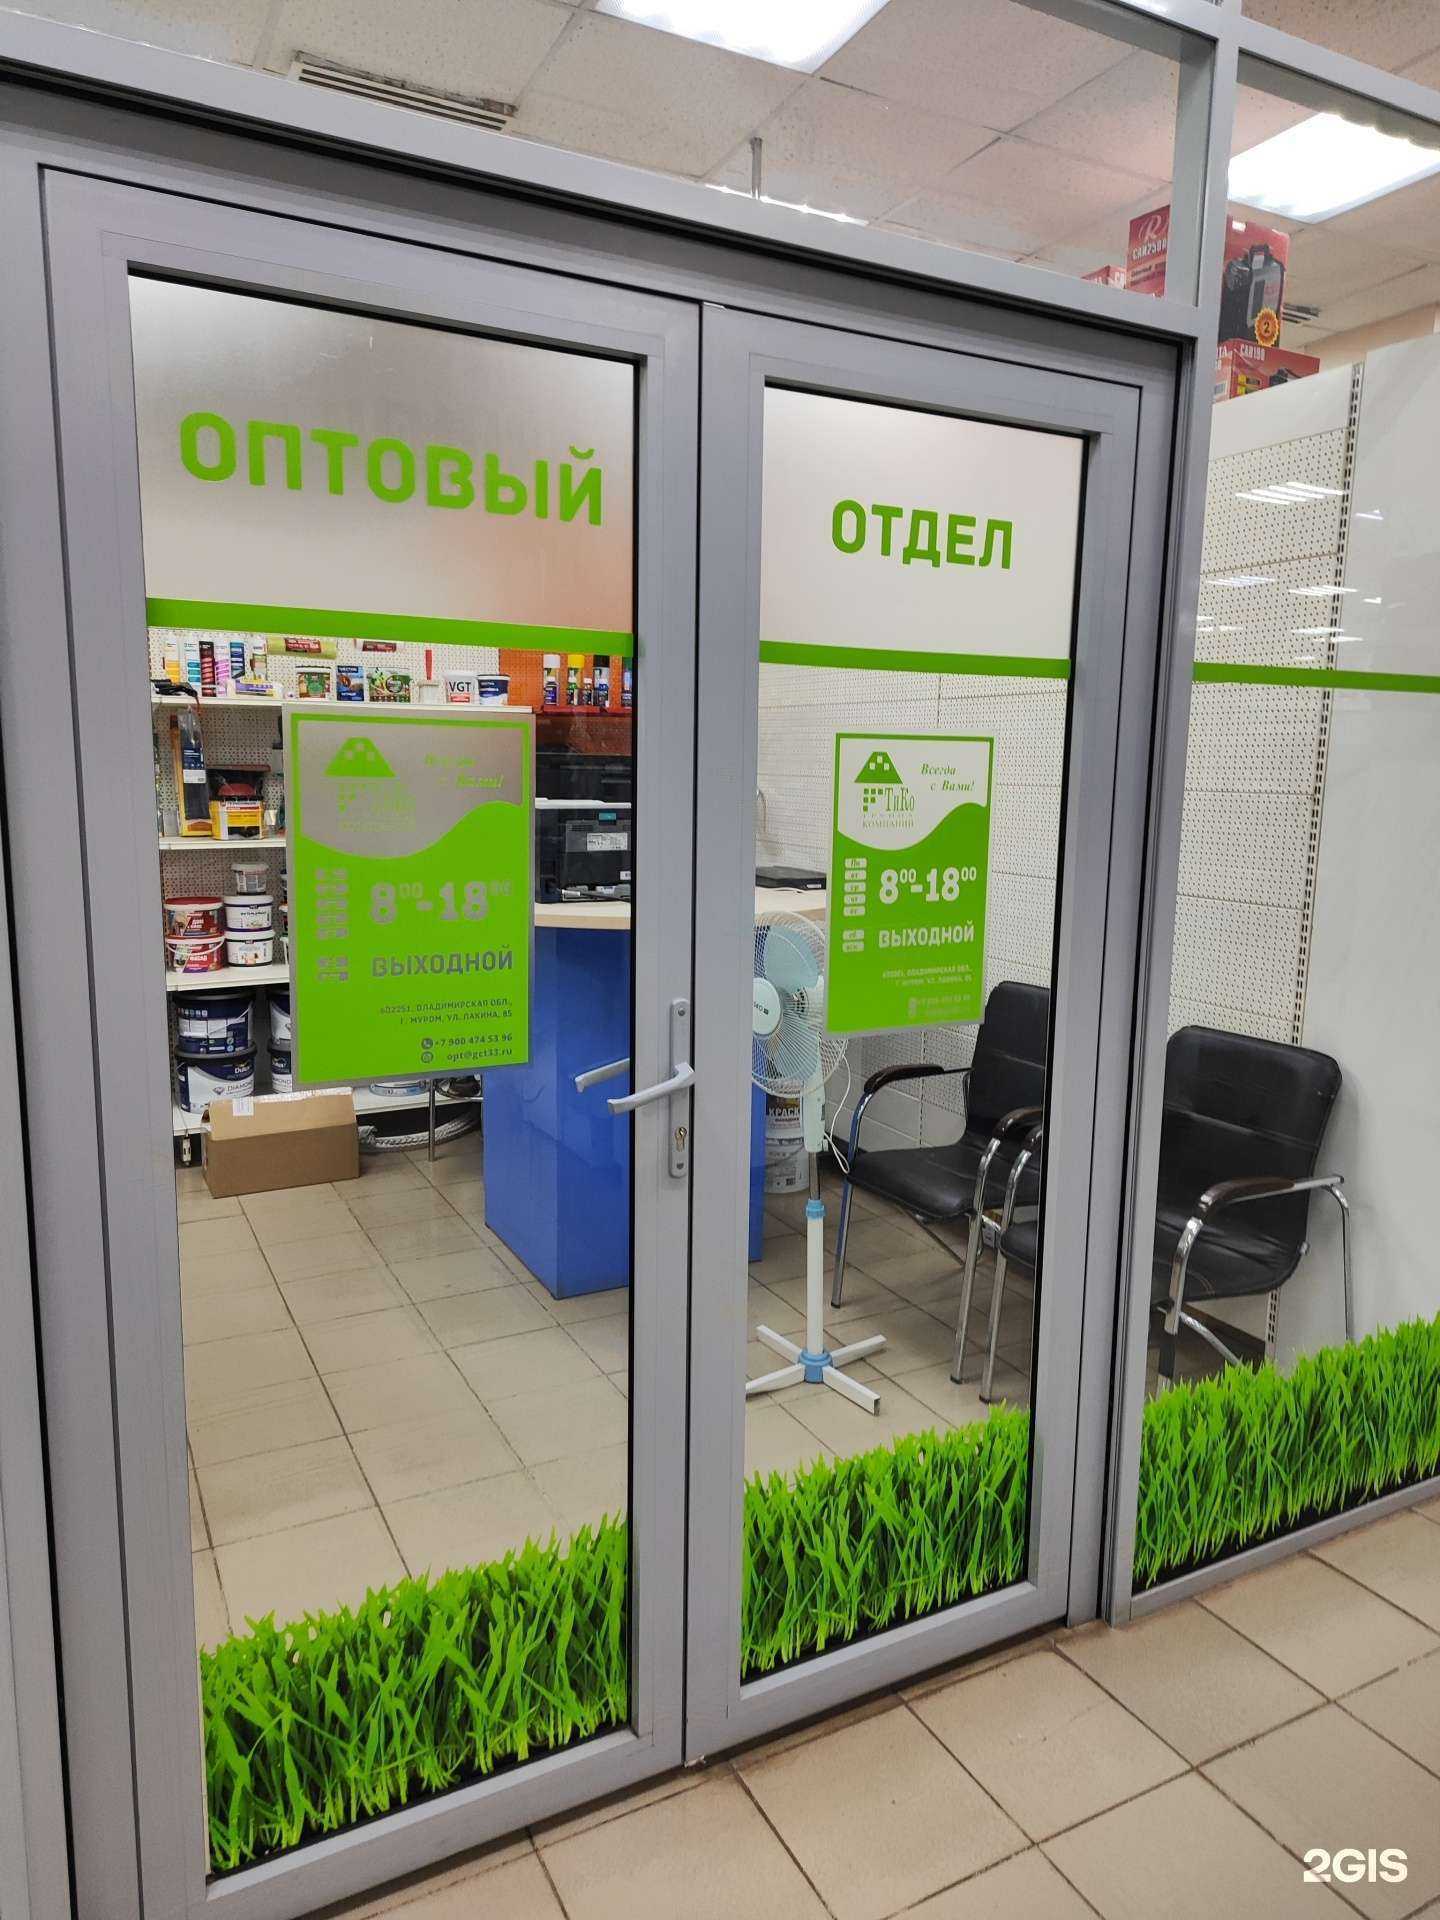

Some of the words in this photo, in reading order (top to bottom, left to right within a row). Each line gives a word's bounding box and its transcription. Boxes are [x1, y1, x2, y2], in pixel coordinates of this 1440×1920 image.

[180, 412, 603, 526] ОПТОВЫЙ
[832, 499, 1013, 569] ОТДЕЛ
[449, 681, 472, 692] VGT
[921, 763, 957, 777] Всегда
[942, 779, 976, 792] Вами!
[878, 920, 975, 949] ВЫХОДНОЙ
[371, 944, 513, 978] ВЫХОДНОЙ
